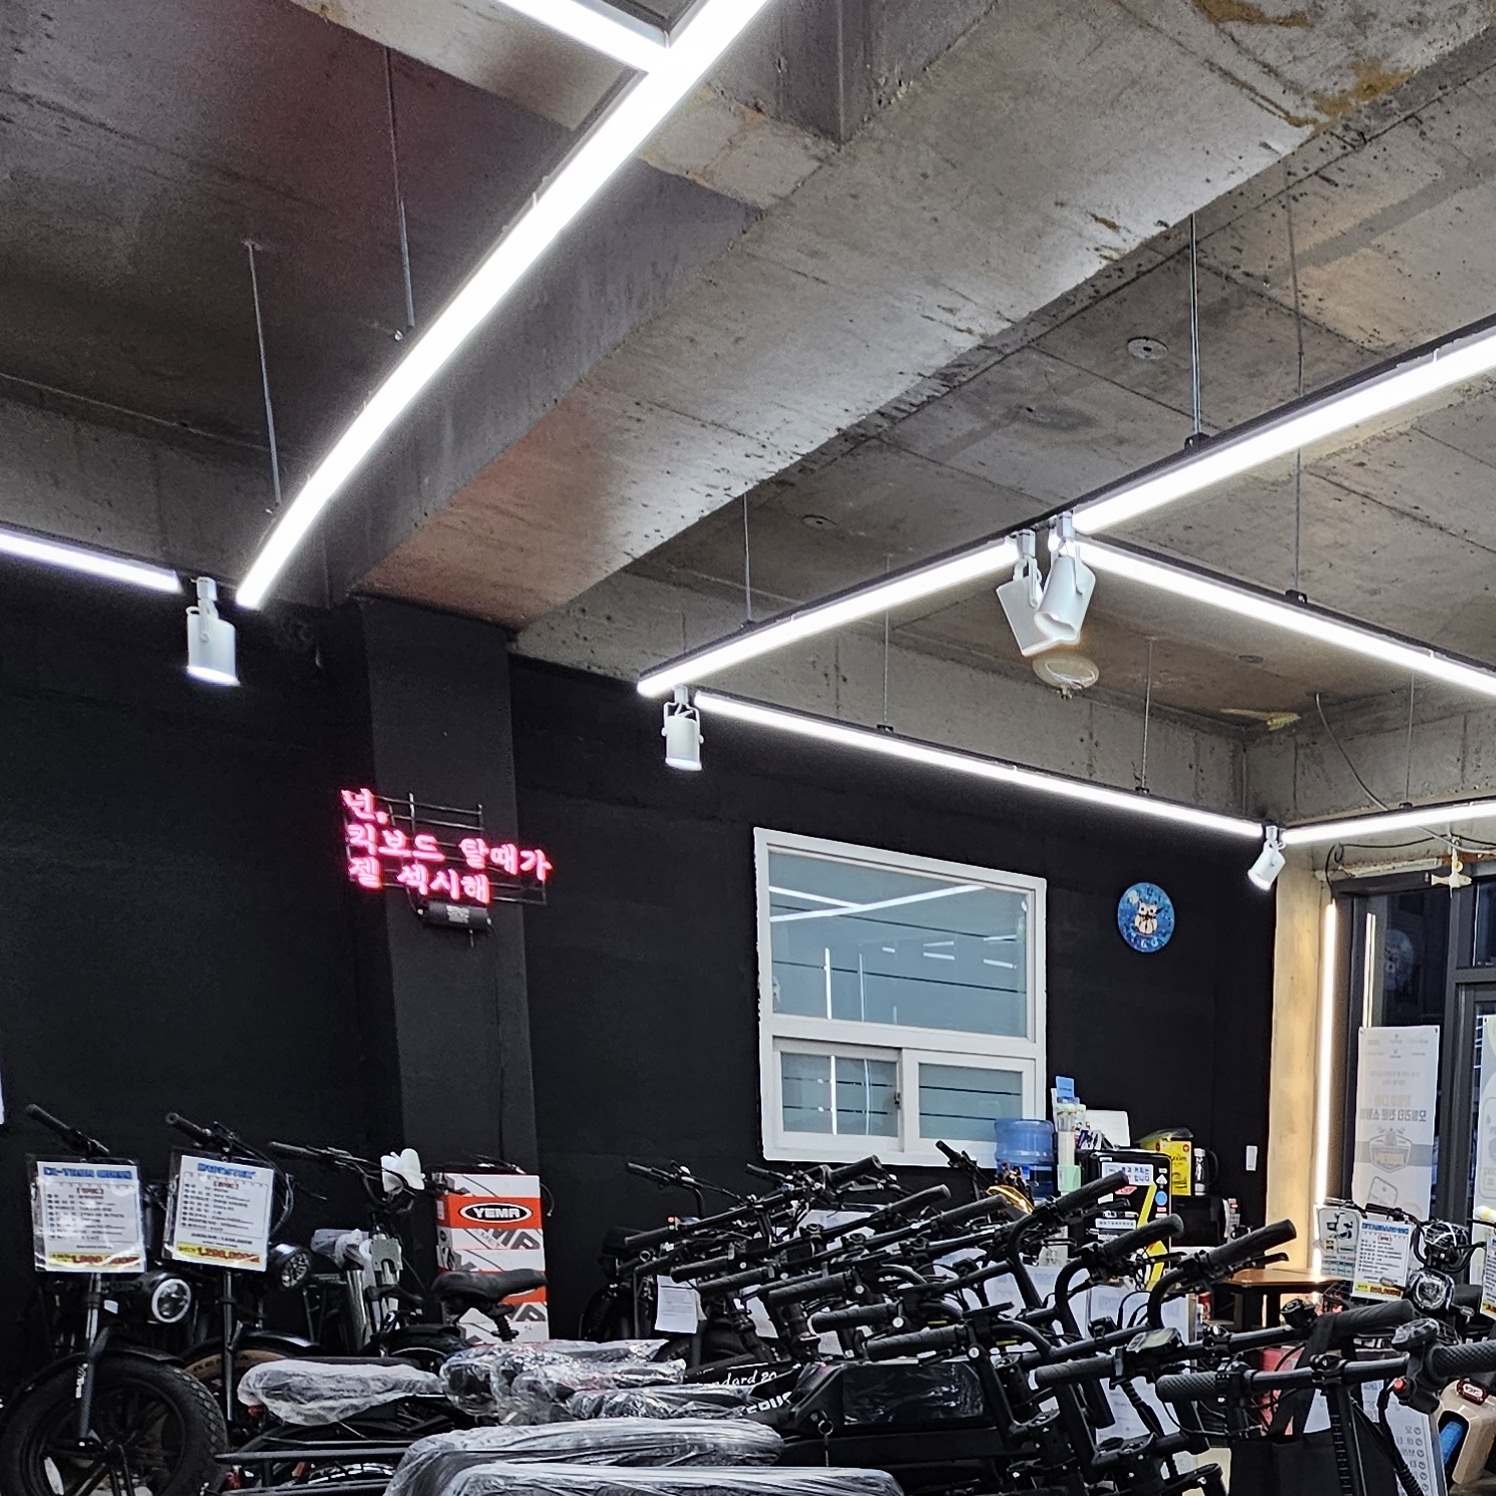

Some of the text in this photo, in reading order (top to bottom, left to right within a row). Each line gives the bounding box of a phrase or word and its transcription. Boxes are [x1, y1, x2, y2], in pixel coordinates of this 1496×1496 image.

[347, 823, 553, 882] 킥보드 탈때가
[397, 864, 490, 904] 섹시해
[473, 1207, 521, 1219] YEMA
